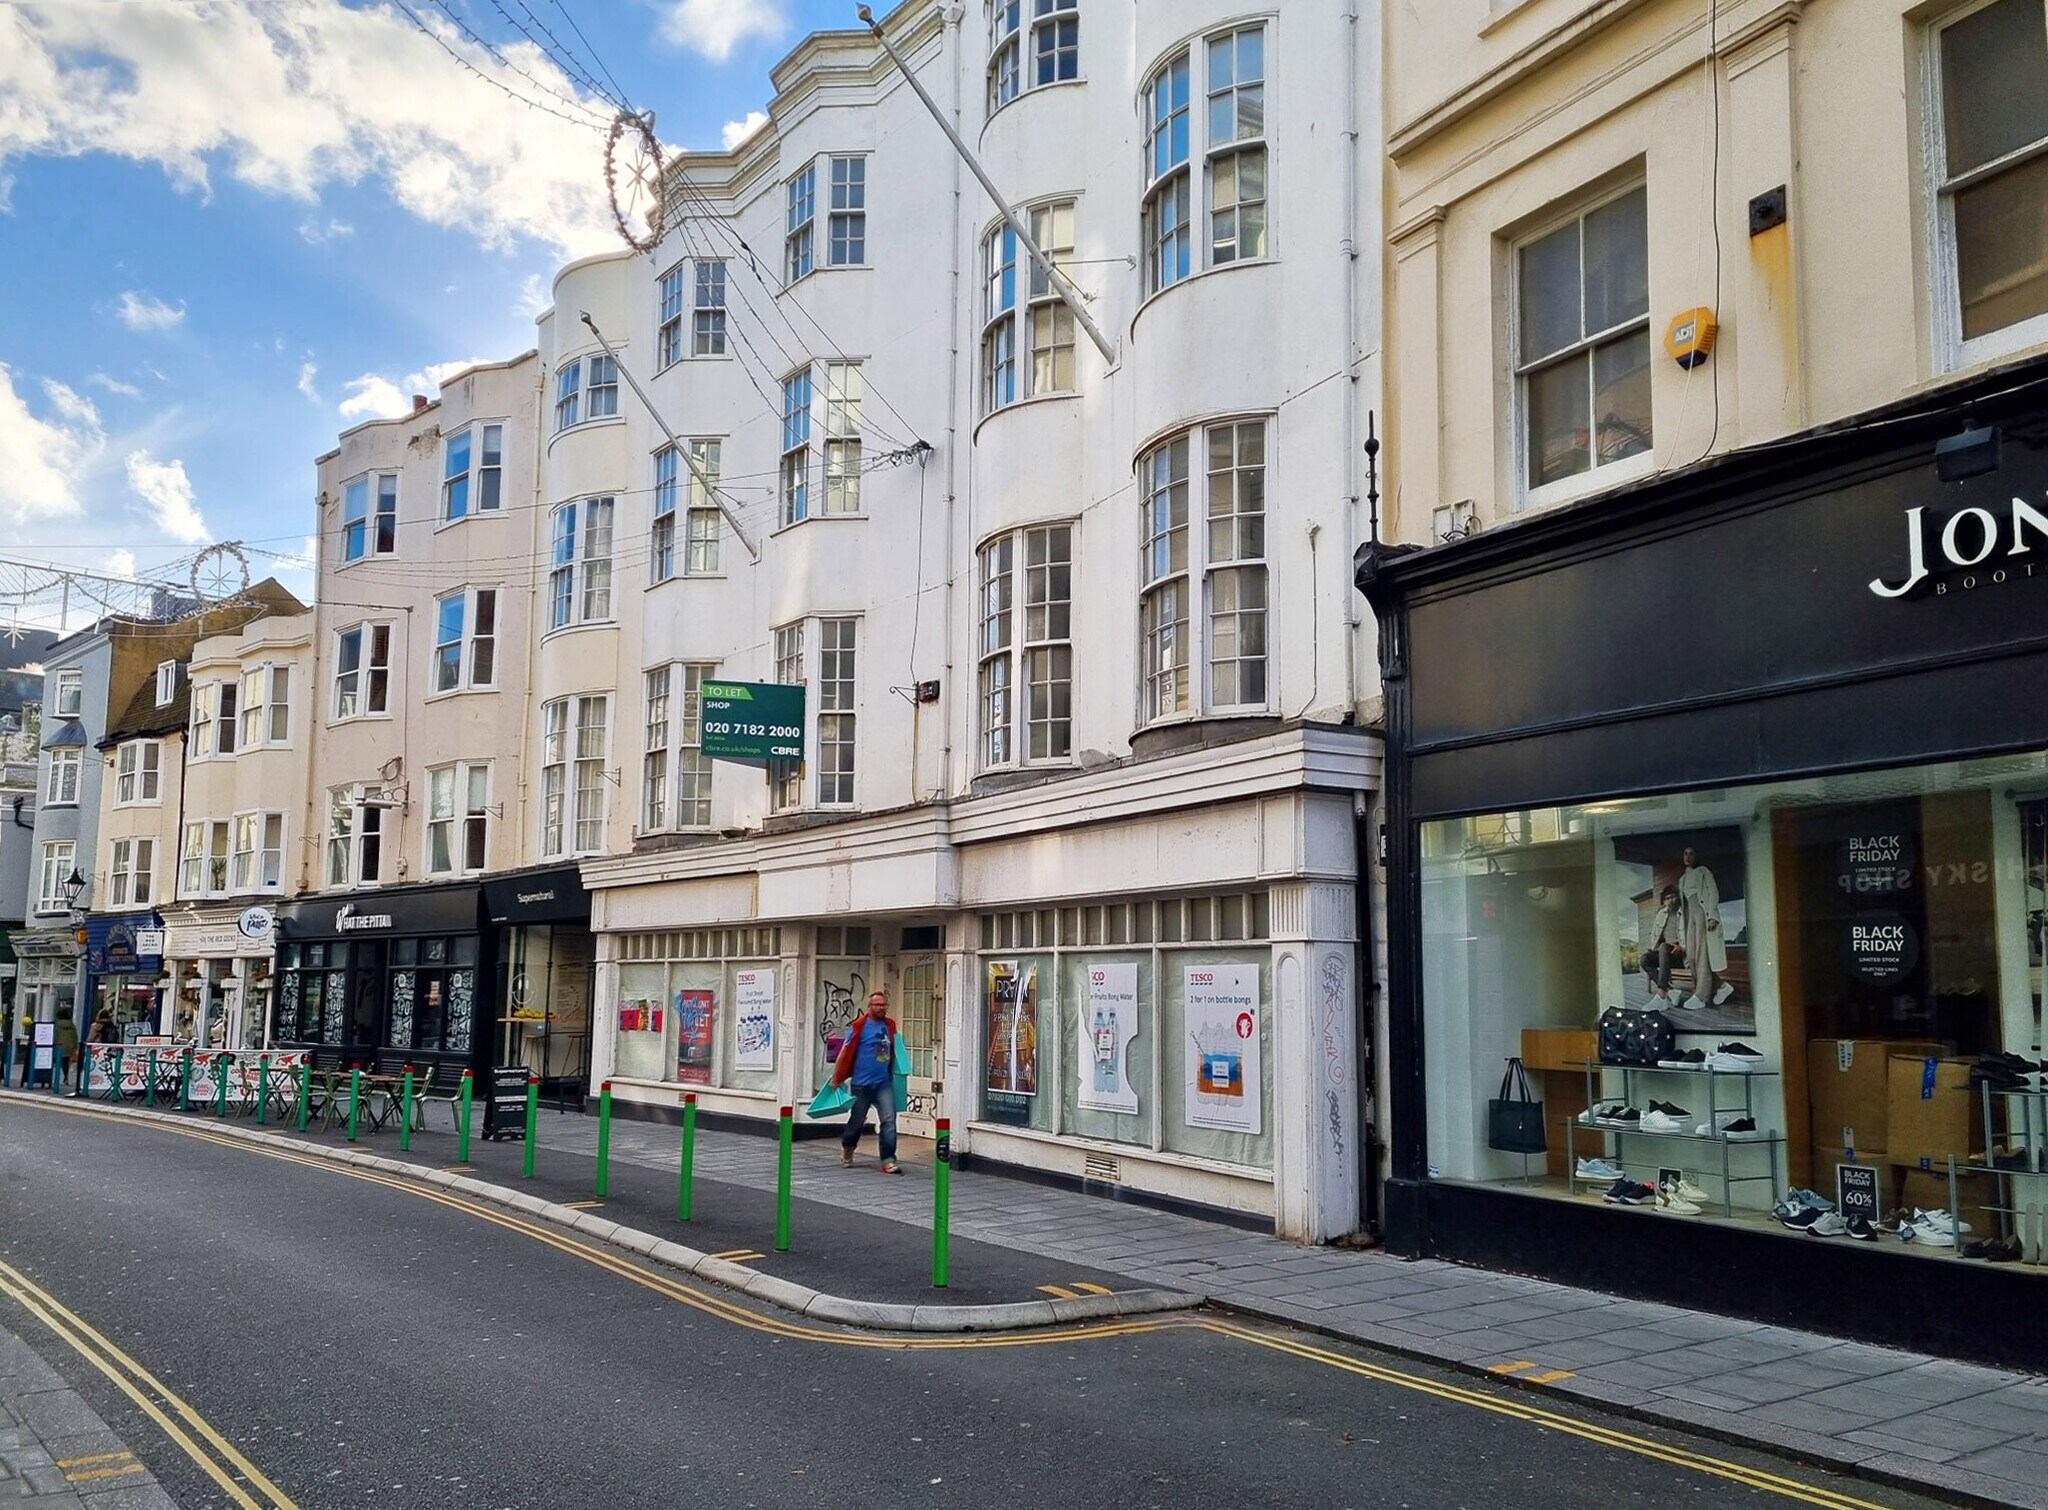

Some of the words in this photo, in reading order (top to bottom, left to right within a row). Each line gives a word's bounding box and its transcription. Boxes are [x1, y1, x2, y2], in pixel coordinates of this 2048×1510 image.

[1674, 323, 1695, 343] ADT
[1936, 563, 2036, 595] BOOT
[708, 687, 722, 696] TO
[725, 688, 742, 697] LET
[706, 701, 730, 709] SHOP
[705, 722, 730, 734] 020
[733, 723, 765, 736] 7182
[768, 726, 800, 738] 2000
[770, 746, 800, 756] CBRE
[1850, 835, 1900, 850] BLACK
[1850, 849, 1900, 863] FRIDAY
[1852, 926, 1903, 939] BLACK
[1853, 939, 1904, 952] FRIDAY
[738, 974, 756, 982] TESCO
[1190, 973, 1213, 982] TESCO
[1216, 995, 1233, 1004] bottle
[1234, 995, 1252, 1006] bongs
[1844, 1170, 1871, 1181] BLACK
[1844, 1177, 1871, 1187] FRIDAY
[1845, 1192, 1872, 1206] 60%
